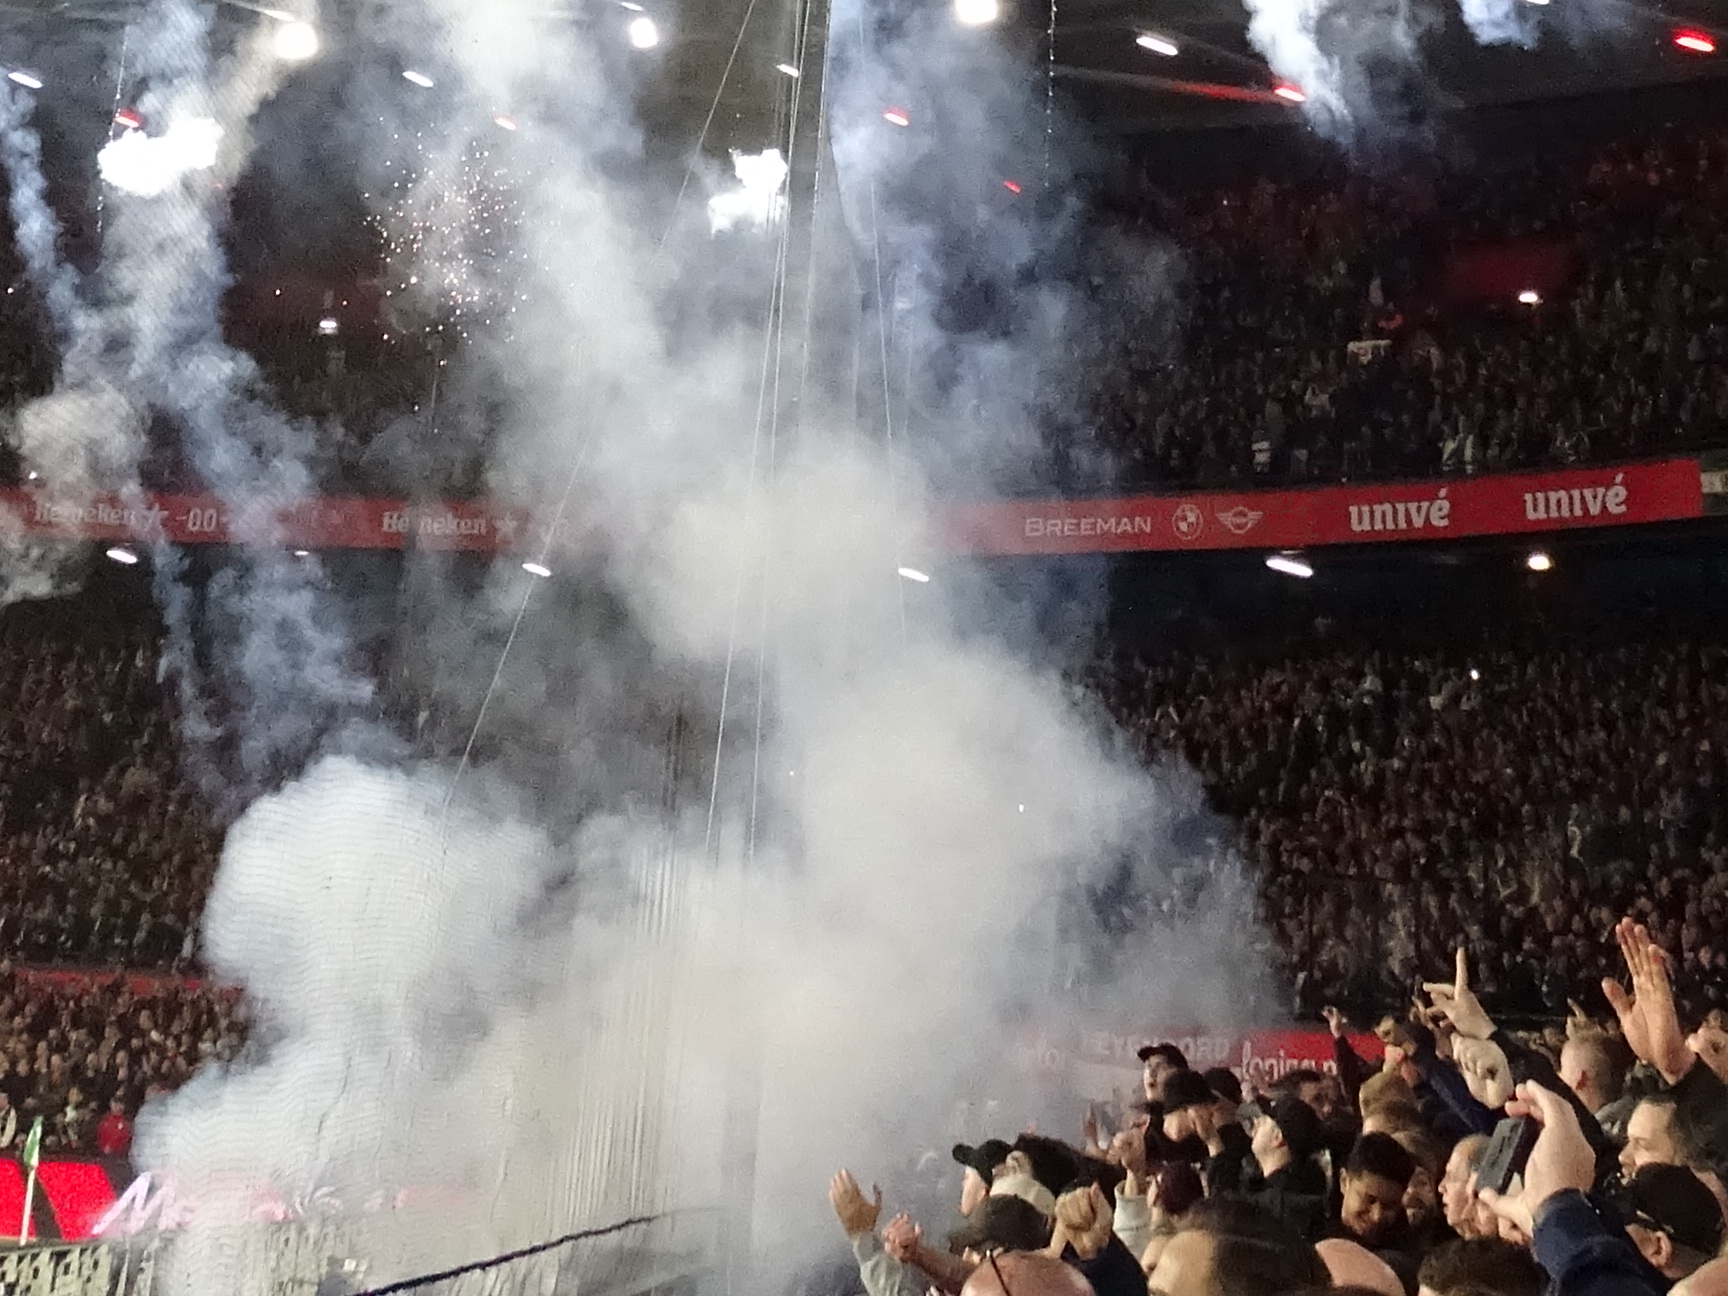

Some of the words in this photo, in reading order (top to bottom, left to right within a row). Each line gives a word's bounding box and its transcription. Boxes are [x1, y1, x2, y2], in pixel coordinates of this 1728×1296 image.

[1348, 487, 1451, 533] univé
[1523, 473, 1628, 521] univé
[382, 510, 487, 535] Heneken
